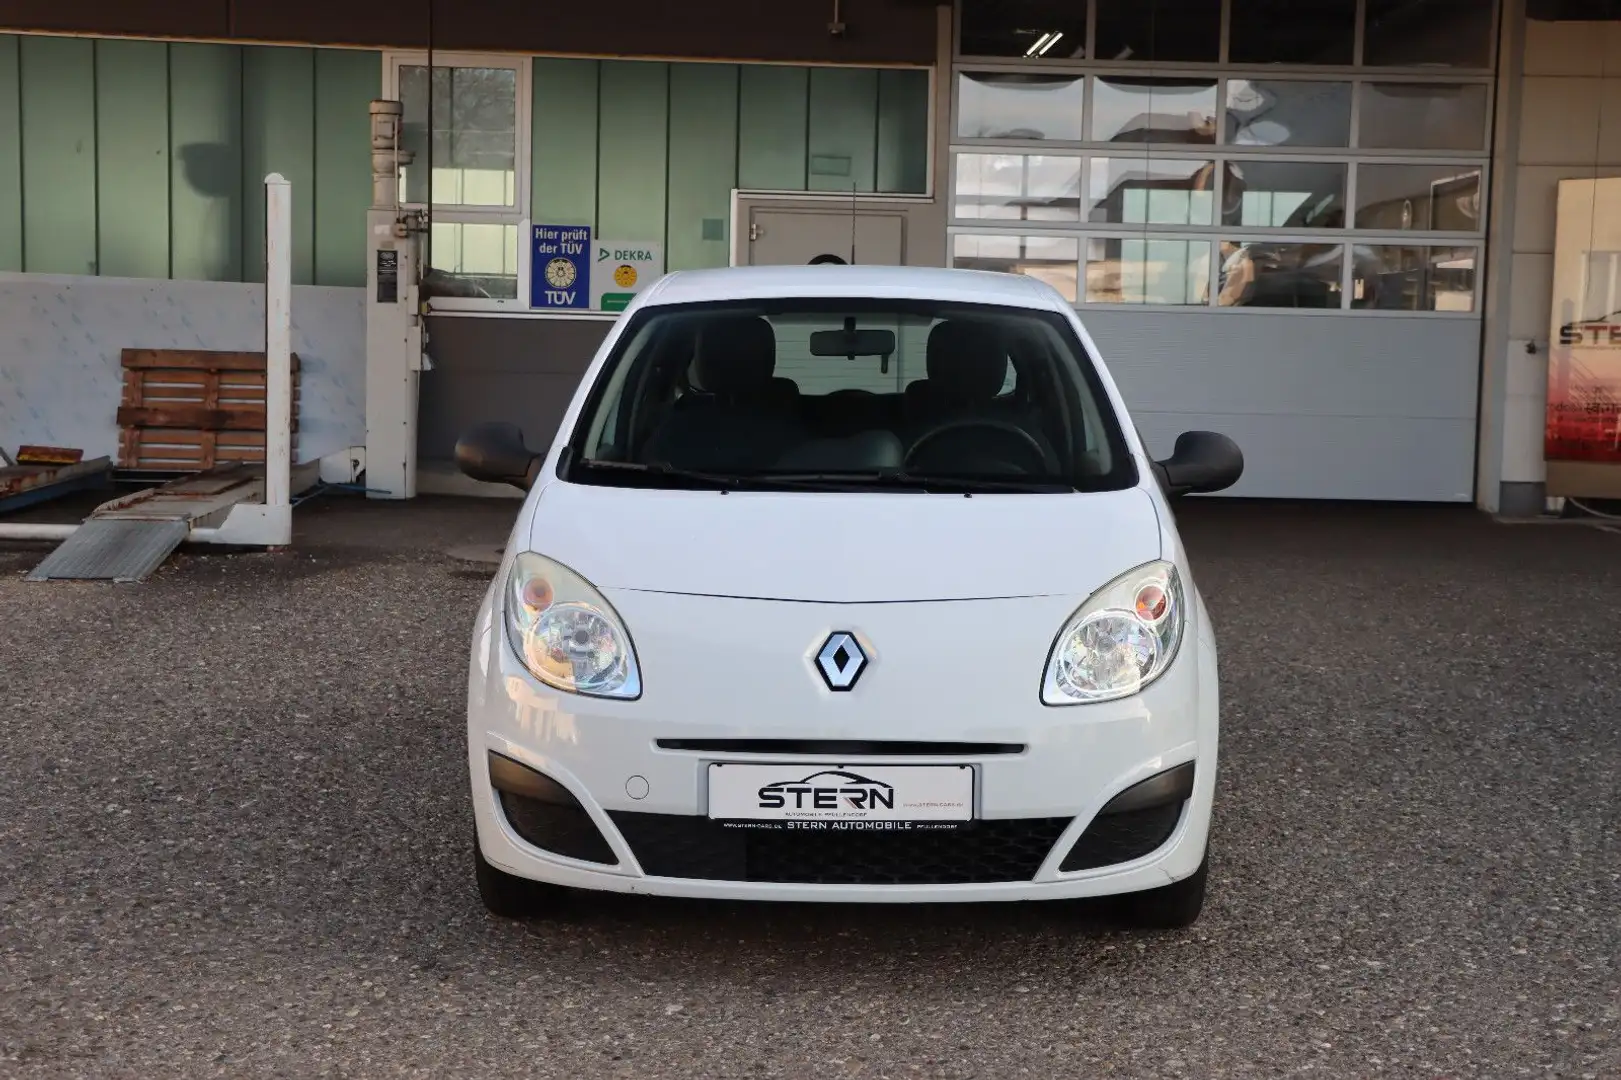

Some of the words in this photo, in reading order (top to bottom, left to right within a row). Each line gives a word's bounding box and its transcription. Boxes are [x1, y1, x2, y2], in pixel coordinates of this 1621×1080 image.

[535, 228, 558, 240] Hier
[561, 229, 588, 242] prüft
[539, 242, 558, 254] der
[561, 240, 583, 255] TÜV
[614, 250, 653, 261] DEKRA
[544, 290, 576, 305] TÜV
[758, 787, 894, 810] STERN
[787, 821, 827, 829] STERN
[831, 821, 912, 830] AUTOMOBILE
